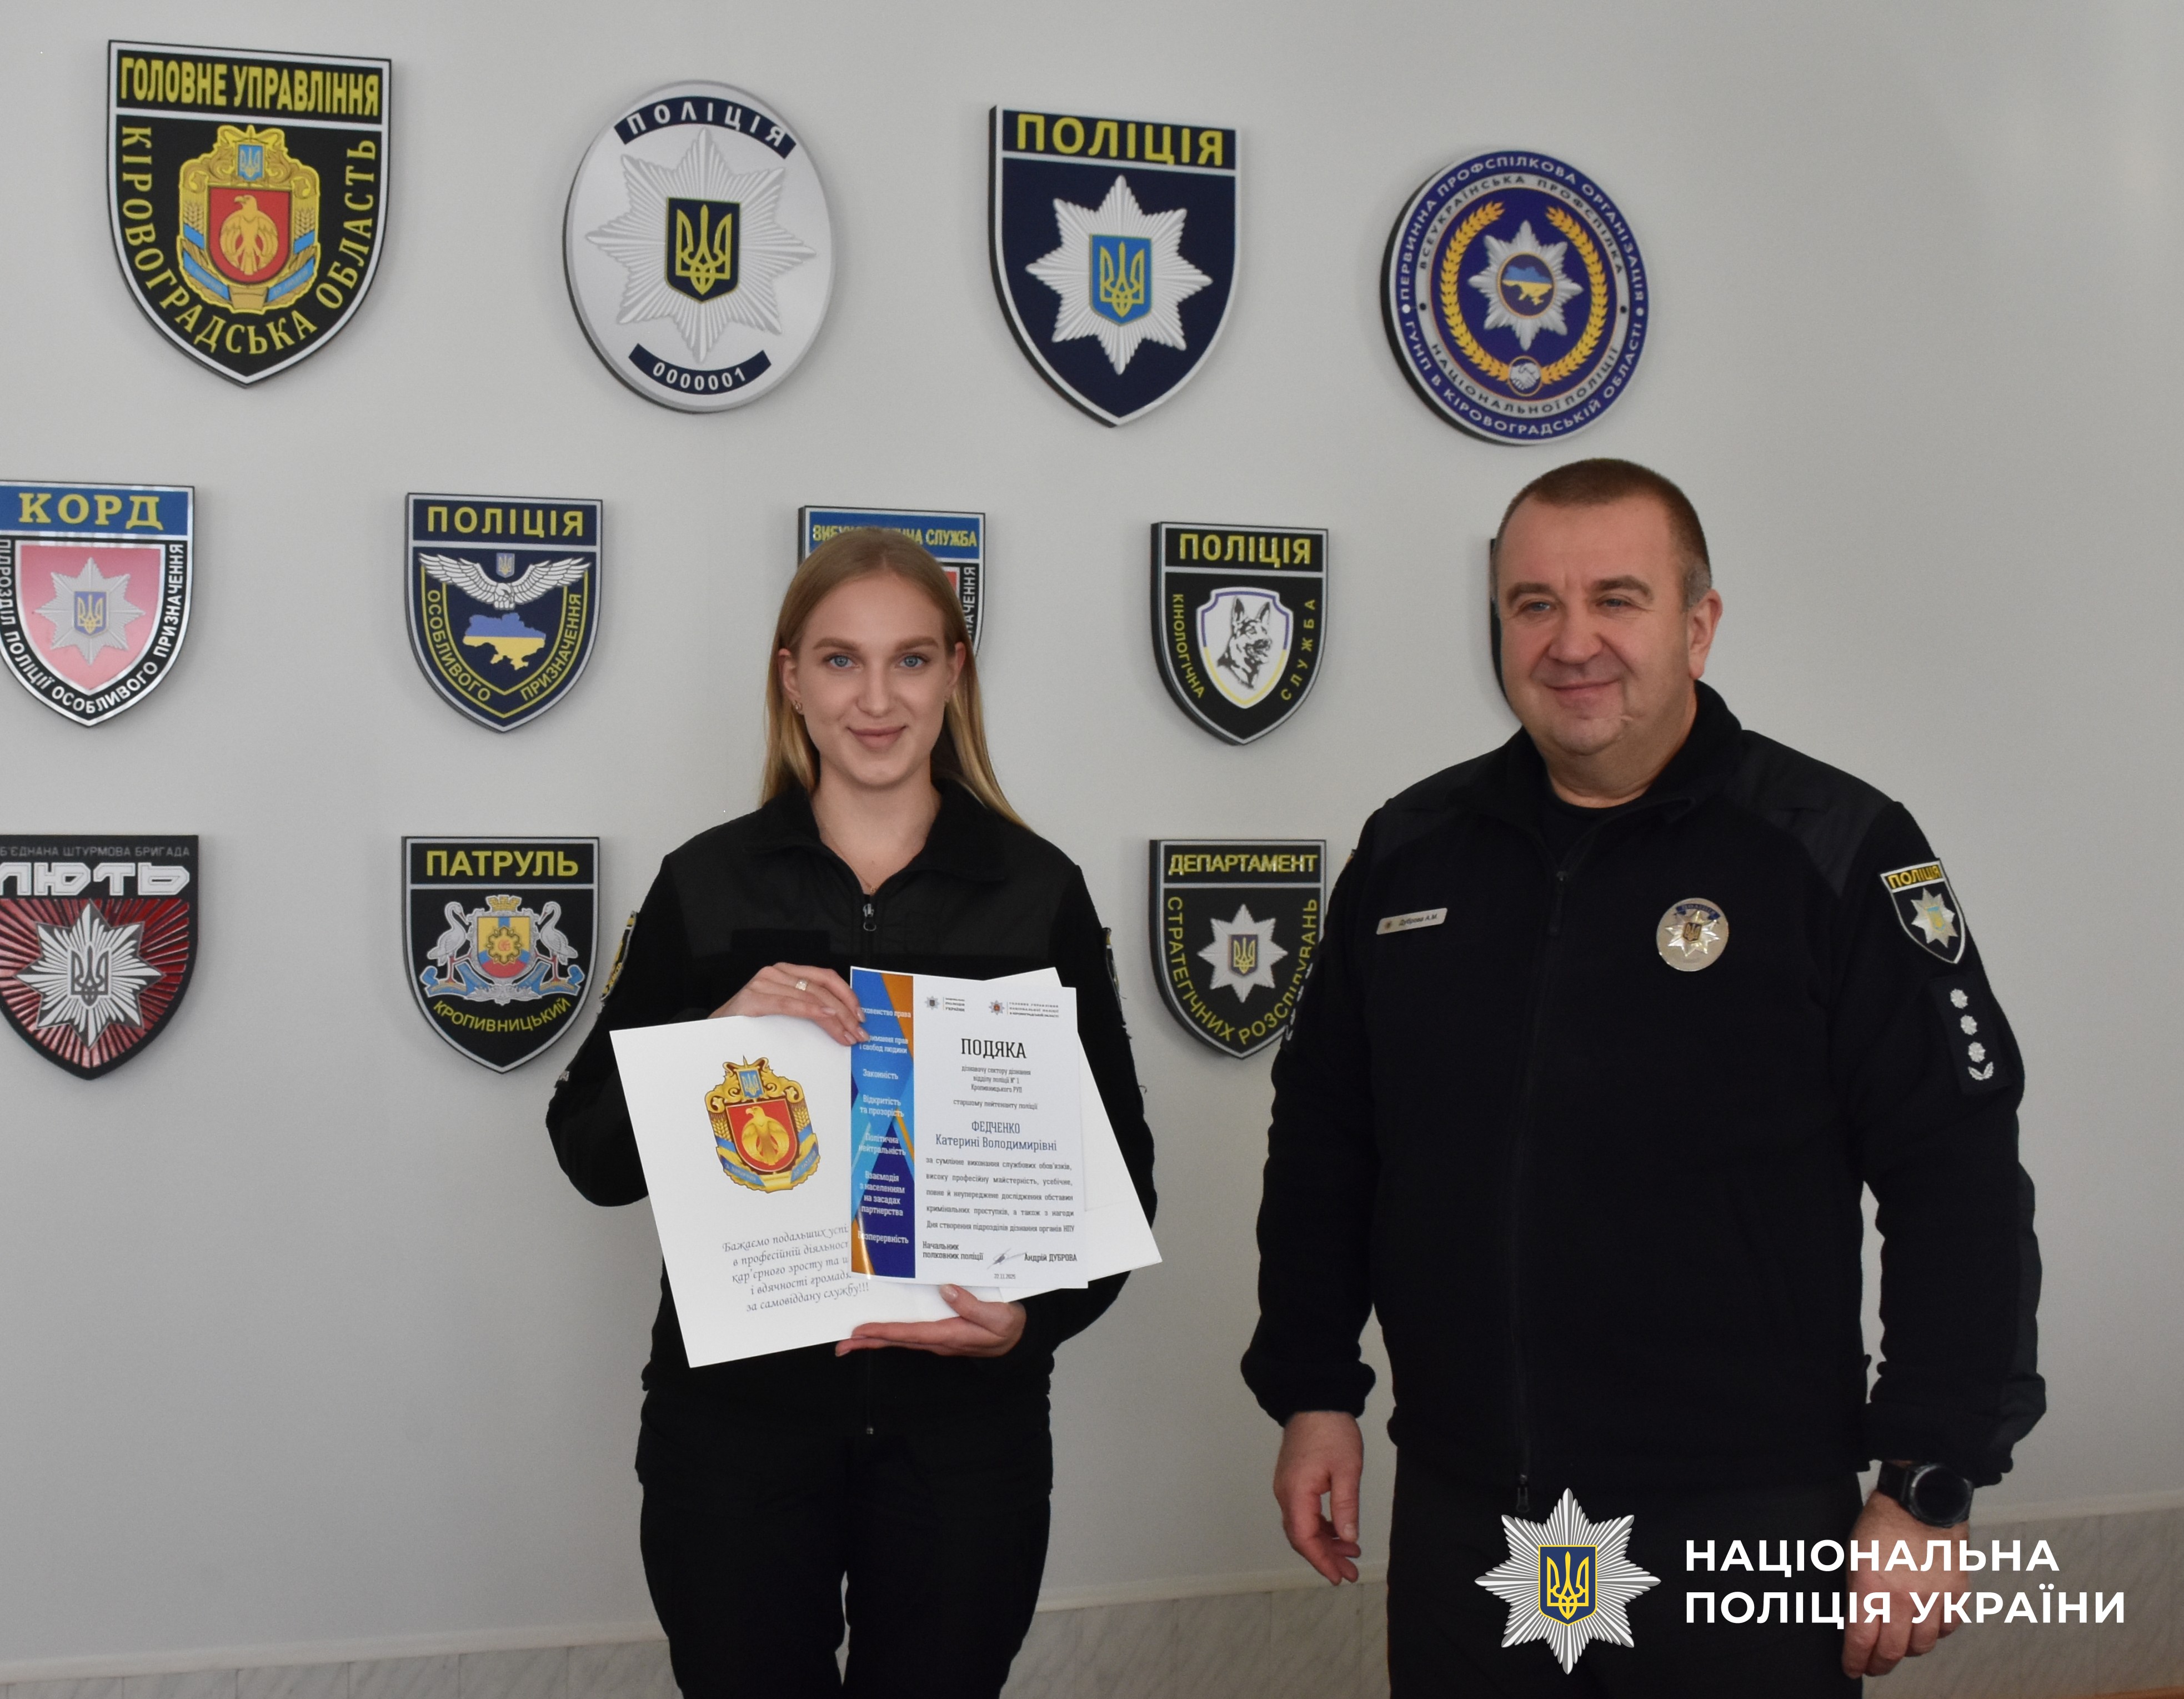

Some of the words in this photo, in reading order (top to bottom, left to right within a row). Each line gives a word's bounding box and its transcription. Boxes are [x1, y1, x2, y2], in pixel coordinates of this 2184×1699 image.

[121, 57, 227, 106] ГОЛОВНЕ
[233, 65, 379, 117] УПРАВЛІННЯ
[625, 101, 786, 148] ПОЛІЦІЯ
[1017, 113, 1223, 166] ПОЛІЦІЯ
[1400, 199, 1436, 299] ПЕРВИННА
[1437, 157, 1576, 197] ПРОФСПІЛКОВА
[1582, 183, 1644, 301] ОРГАНІЗАЦІЯ
[1420, 176, 1525, 269] ВСЕУКРАЇНСЬКА
[1537, 179, 1623, 274] ПРОФСПІЛКА
[122, 126, 317, 354] КІРОВОГРАДСЬКА
[315, 139, 376, 309] ОБЛАСТЬ
[653, 361, 745, 391] 0000001
[1405, 320, 1432, 371] ГУНП
[1431, 376, 1441, 387] В
[1444, 388, 1602, 436] КІРОВОГРАДСЬКІЙ
[1604, 323, 1642, 399] ОБЛАСТІ
[1431, 343, 1562, 414] НАЦІОНАЛЬНОЇ
[1565, 347, 1619, 406] ПОЛІЦІЇ
[18, 493, 164, 531] КОРД
[428, 506, 583, 538] ПОЛІЦІЯ
[926, 529, 977, 547] СЛУЖБА
[1180, 533, 1311, 568] ПОЛІЦІЯ
[4, 631, 55, 689] ПОЛІЦІЇ
[52, 662, 158, 713] ОСОБЛИВОГО
[154, 544, 183, 657] ПРИЗНАЧЕННЯ
[428, 590, 491, 701] ОСОБЛИВОГО
[520, 594, 581, 701] ПРИЗНАЧЕННЯ
[1173, 594, 1205, 698] КІНОЛОГІЧНА
[1281, 599, 1315, 700] СЛУЖБА
[0, 846, 59, 858] Б'ЄДНАНА
[63, 846, 131, 857] ШТУРМОВА
[136, 847, 190, 857] БРИГАДА
[427, 851, 578, 876] ПАТРУЛЬ
[1168, 854, 1318, 876] ДЕПАРТАМЕНТ
[1889, 866, 1942, 889] ПОЛІЦІЯ
[1168, 897, 1235, 1041] СТРАТЕГІЧНИХ
[433, 997, 572, 1032] КРОПИВНИЦЬКИЙ
[863, 1044, 883, 1053] свобод
[961, 1038, 1026, 1059] ПОДЯКА
[863, 1068, 899, 1080] Законність
[961, 1065, 986, 1074] дізнавачу
[971, 1084, 1012, 1093] Кропивницького
[863, 1094, 901, 1106] Відкритість
[984, 1101, 1018, 1110] лейтенанту
[869, 1108, 904, 1117] прозорість
[971, 1120, 1020, 1134] ФЕДЧЕНКО
[865, 1133, 899, 1144] Політична
[935, 1133, 980, 1148] Катерині
[983, 1137, 1057, 1153] Володимирівні
[859, 1145, 906, 1156] нейтральність
[936, 1157, 964, 1166] сумлінне
[1002, 1161, 1036, 1170] службових
[865, 1171, 899, 1182] Взаємодія
[952, 1175, 989, 1183] професійну
[993, 1177, 1039, 1186] майстерність,
[865, 1183, 905, 1193] населенням
[873, 1196, 901, 1205] засадах
[926, 1205, 970, 1214] кримінальних
[861, 1206, 904, 1216] партнерства
[926, 1220, 938, 1229] Дня
[973, 1223, 1008, 1232] підрозділів
[722, 1237, 770, 1252] Бажаємо
[773, 1228, 826, 1244] подальших
[825, 1223, 849, 1238] успі
[923, 1241, 959, 1250] Начальник
[741, 1246, 801, 1267] професійній
[1024, 1253, 1048, 1262] Андрій
[1049, 1253, 1077, 1262] ДУБРОВА
[788, 1260, 823, 1275] зросту
[757, 1278, 808, 1295] вдячності
[747, 1302, 758, 1312] за
[760, 1291, 821, 1310] самовіддану
[823, 1282, 869, 1300] службу!!!
